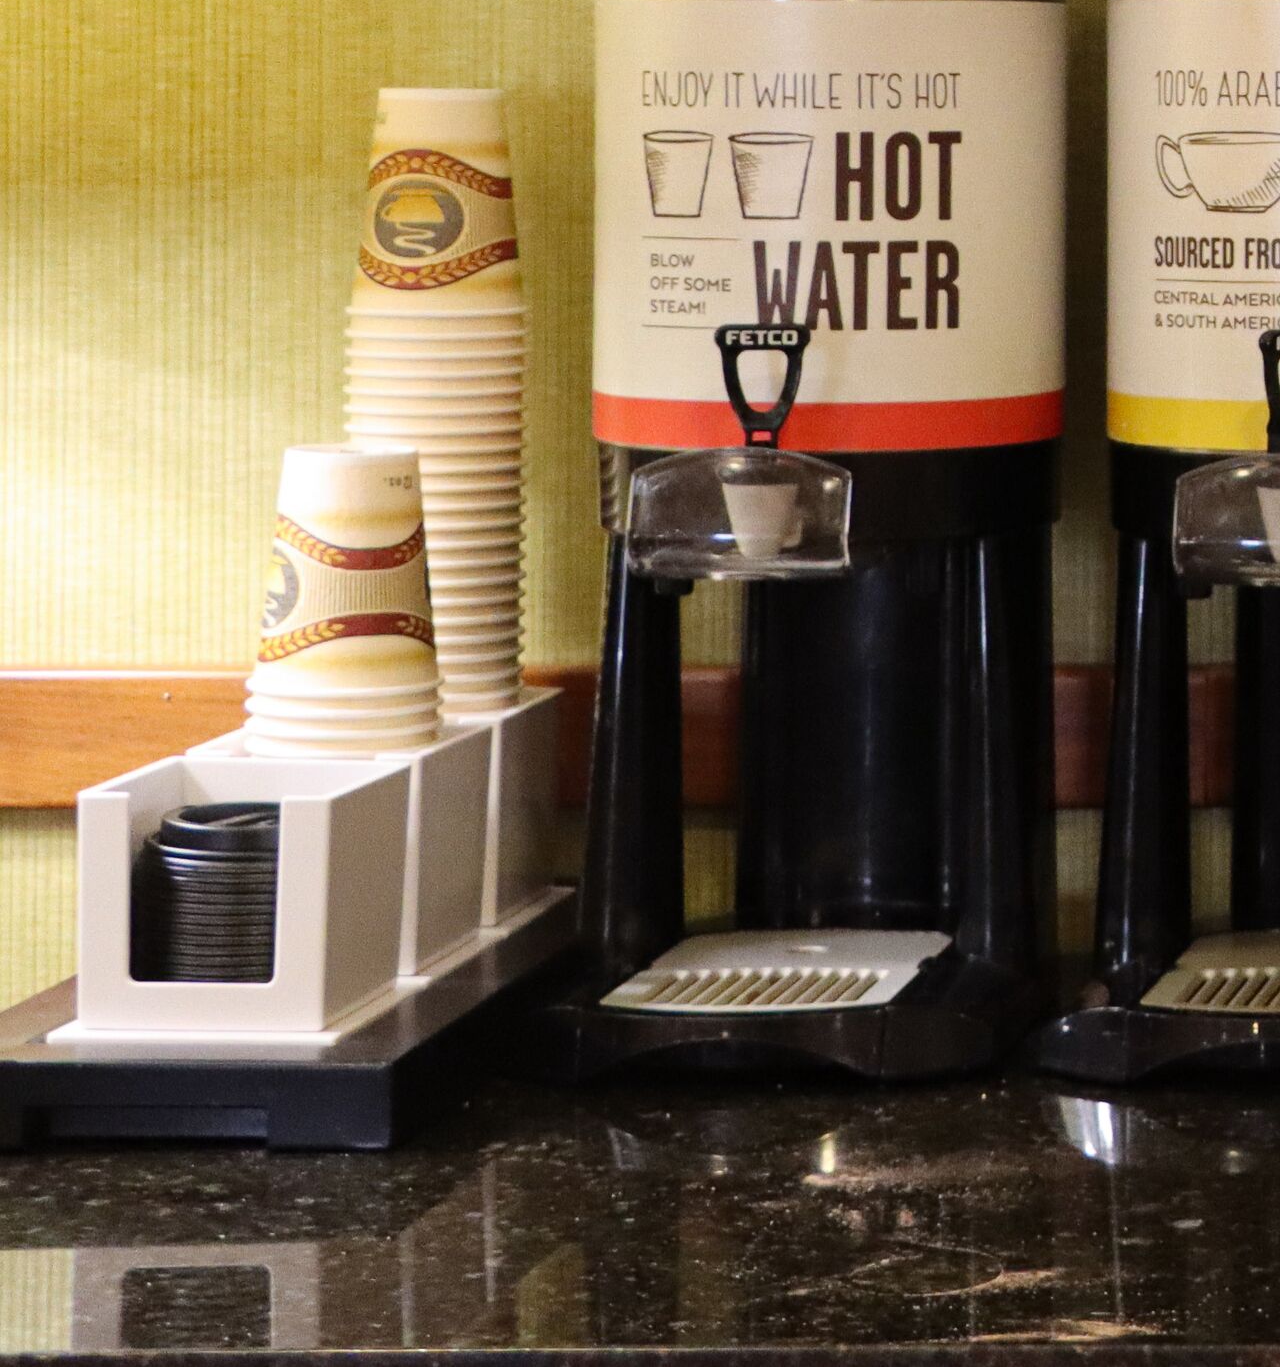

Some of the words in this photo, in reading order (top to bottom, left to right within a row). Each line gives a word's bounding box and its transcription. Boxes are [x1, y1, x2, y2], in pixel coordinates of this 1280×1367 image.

[642, 70, 714, 108] ENJOY
[724, 71, 744, 108] IT
[754, 72, 843, 110] WHILE
[857, 73, 903, 110] IT'S
[914, 73, 961, 110] HOT
[1154, 70, 1208, 107] 100%
[835, 130, 963, 221] HOT
[650, 253, 695, 268] BLOW
[1154, 235, 1235, 270] SOURCED
[649, 276, 680, 291] OFF
[683, 278, 732, 293] SOME
[753, 240, 960, 330] WATER
[1154, 289, 1219, 306] CENTRAL
[650, 299, 706, 315] STEAM!
[1154, 313, 1163, 327] &
[1166, 313, 1217, 329] SOUTH
[725, 329, 799, 346] FETCO
